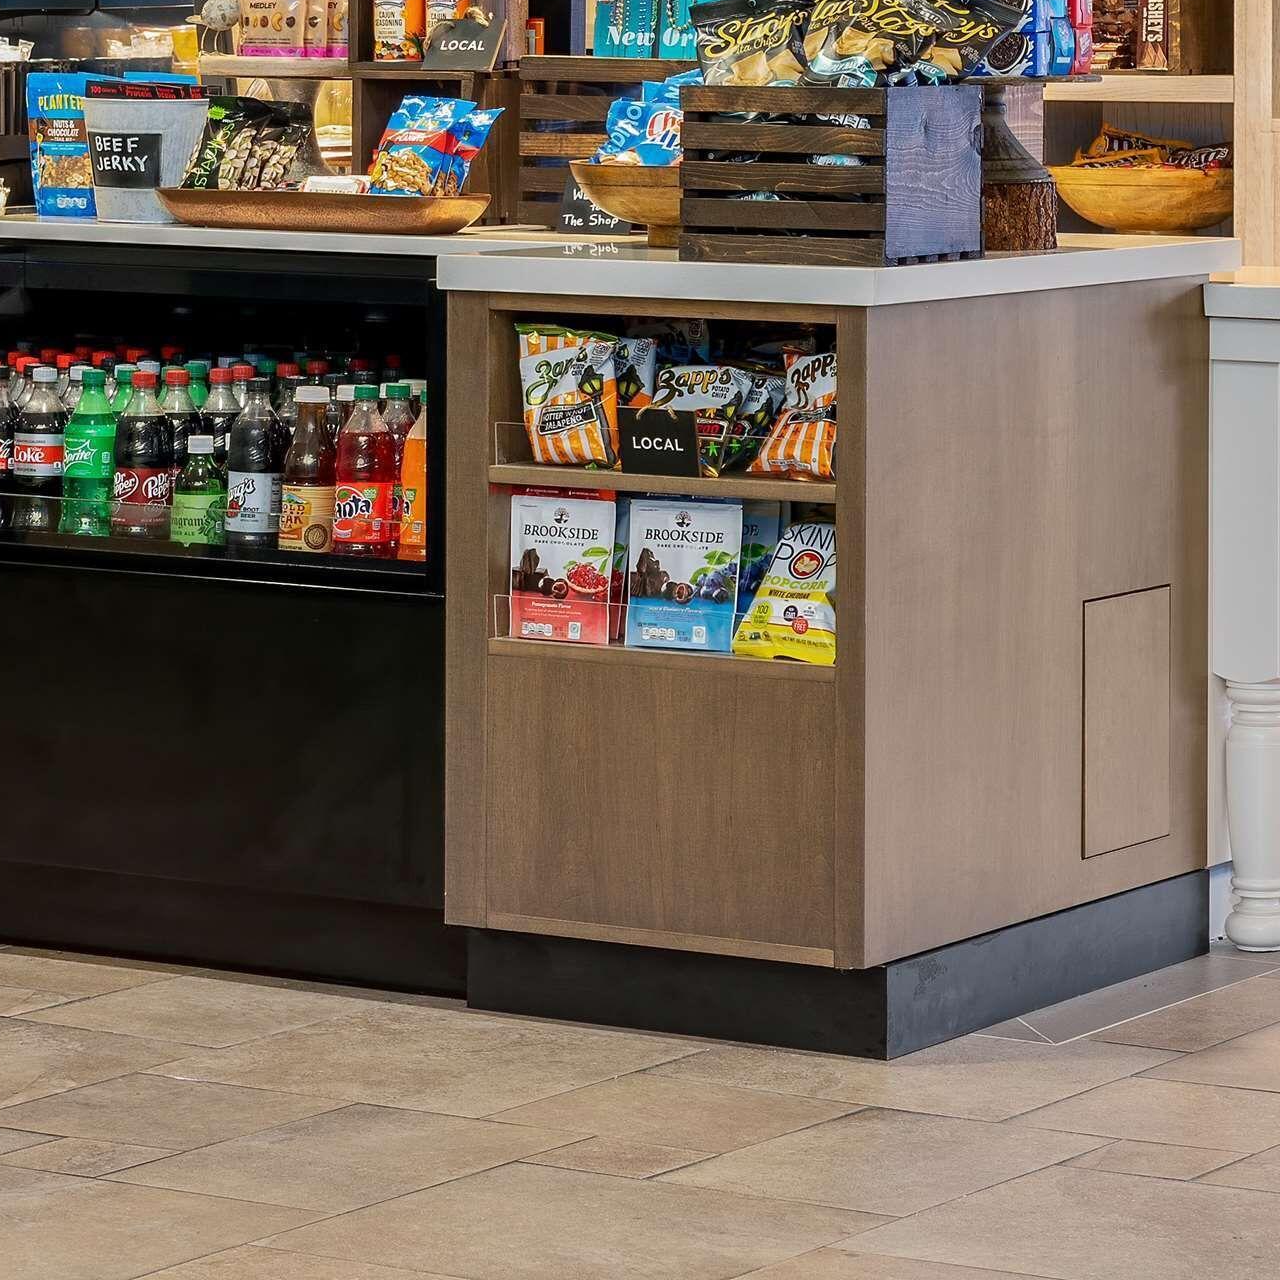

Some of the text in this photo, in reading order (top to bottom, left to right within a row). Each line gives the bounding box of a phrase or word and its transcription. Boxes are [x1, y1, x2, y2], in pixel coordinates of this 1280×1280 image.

[606, 26, 656, 46] New
[440, 40, 485, 51] LOCAL
[53, 120, 75, 128] NUTS &
[48, 128, 79, 137] CHOCOLATE
[95, 136, 139, 152] BEEF
[96, 156, 148, 172] JERKY
[562, 214, 618, 228] The Shop
[632, 436, 684, 452] LOCAL
[14, 446, 44, 462] Coke
[524, 525, 599, 540] BROOKSIDE
[644, 528, 724, 544] BROOKSIDE
[764, 576, 828, 590] POPCORN
[768, 590, 810, 599] WHITE CHEDDAR
[756, 605, 768, 614] 100
